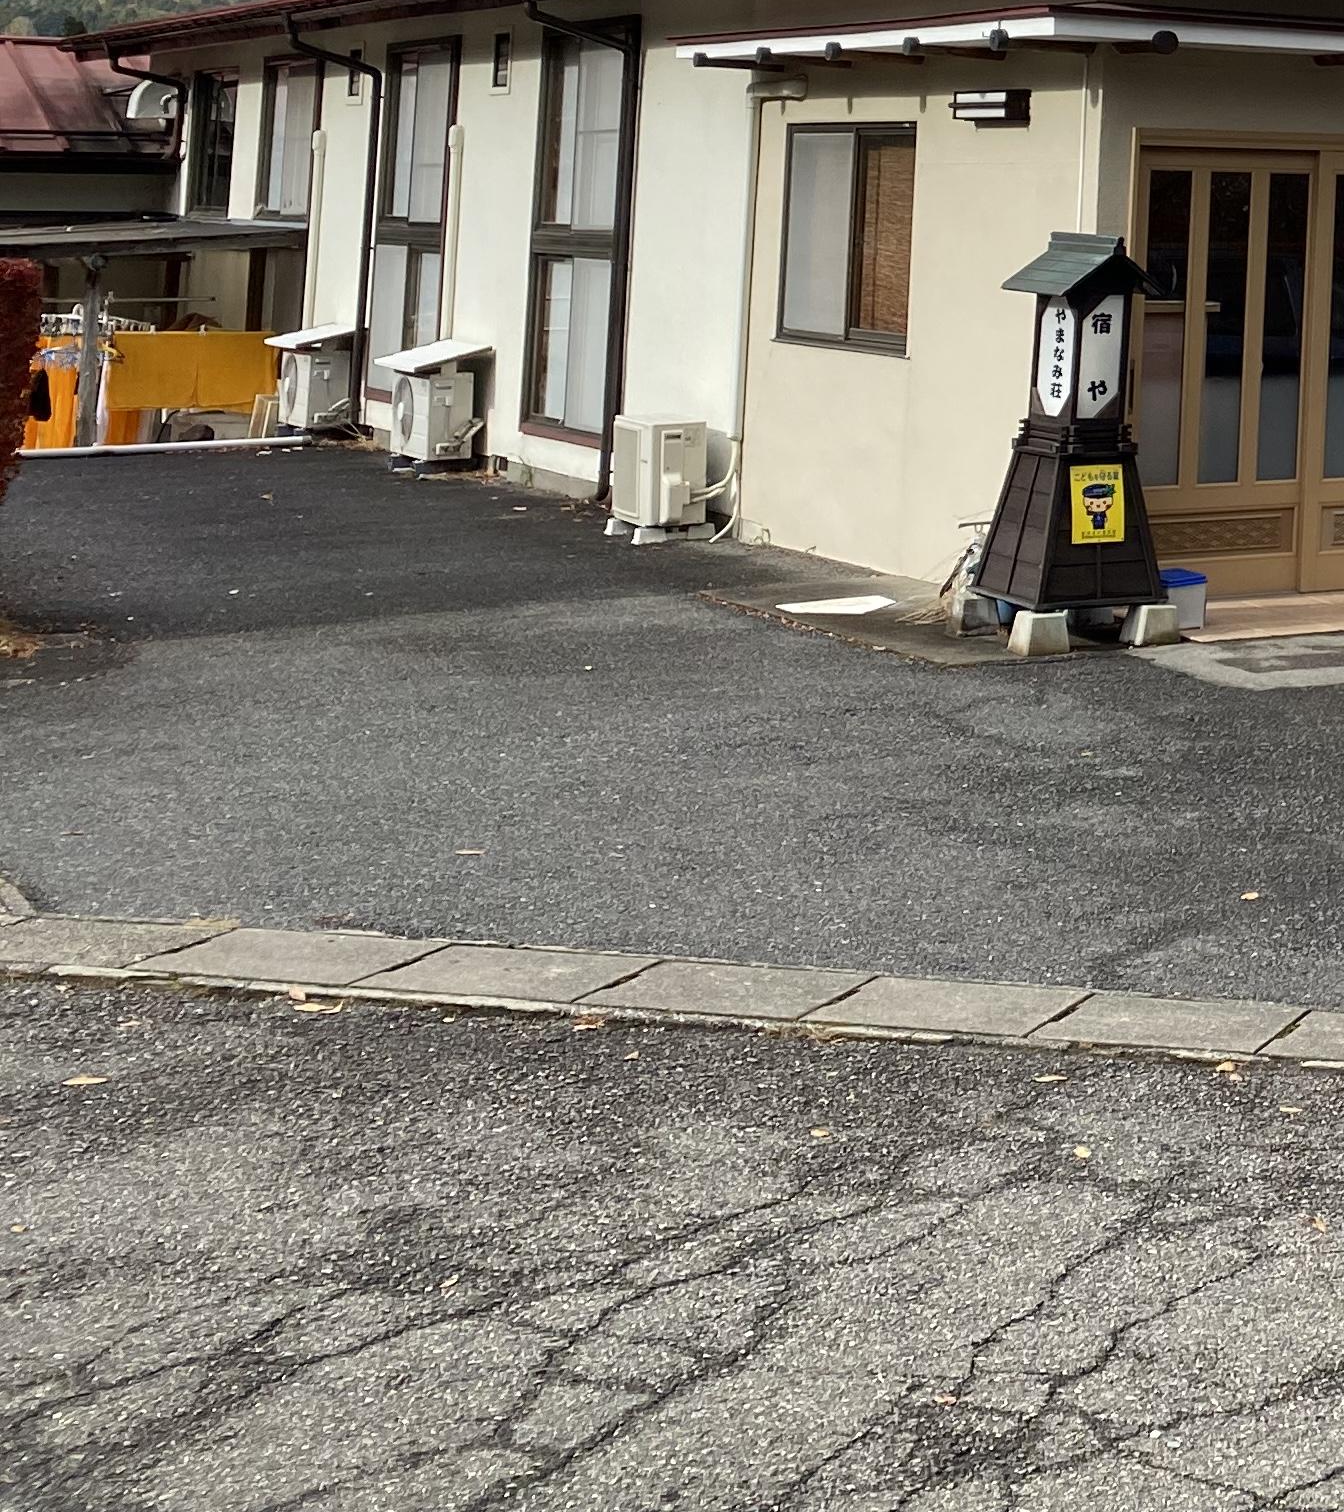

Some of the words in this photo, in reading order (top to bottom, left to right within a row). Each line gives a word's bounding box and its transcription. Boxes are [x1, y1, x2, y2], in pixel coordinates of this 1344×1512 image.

[1050, 308, 1066, 399] やまなみ荘
[1087, 312, 1112, 402] 宿や
